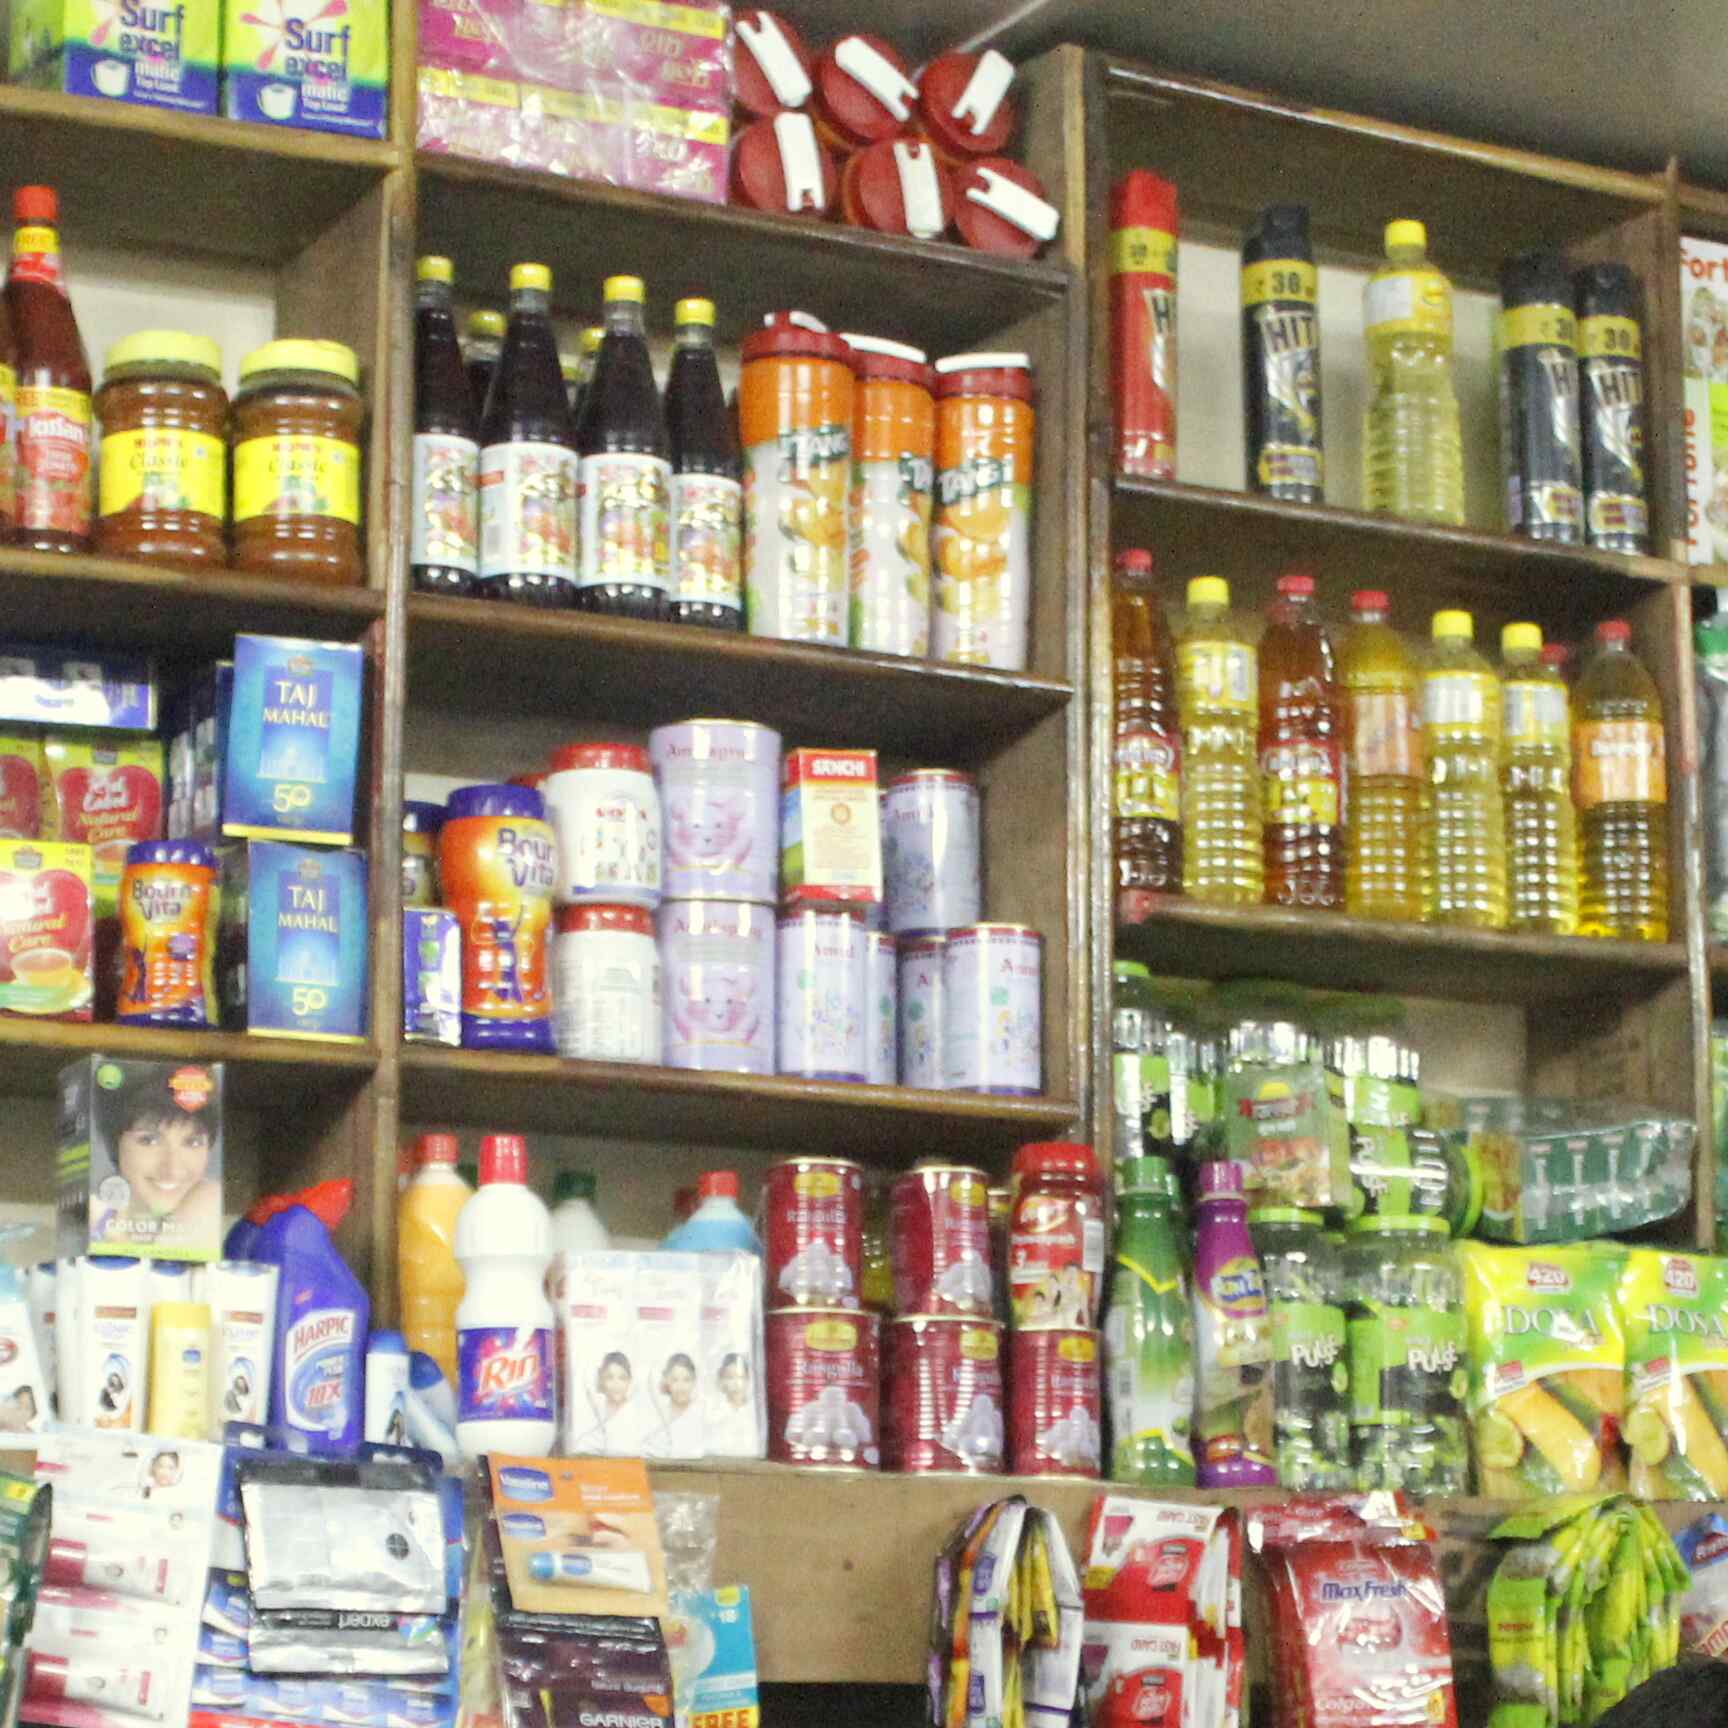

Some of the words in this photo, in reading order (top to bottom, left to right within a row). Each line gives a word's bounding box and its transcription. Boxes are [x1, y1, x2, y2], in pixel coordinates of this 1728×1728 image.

[121, 0, 184, 34] Surf
[122, 32, 182, 61] excel
[285, 17, 352, 55] Surf
[285, 55, 348, 83] excel
[275, 681, 319, 710] TAJ
[263, 707, 330, 729] MAHAL
[273, 782, 313, 814] 50
[287, 884, 327, 912] TAJ
[277, 911, 338, 934] MAHAL
[290, 986, 328, 1018] 50
[292, 1316, 349, 1350] HARPIC
[1648, 1303, 1725, 1339] DOSA
[339, 1613, 390, 1630] expert
